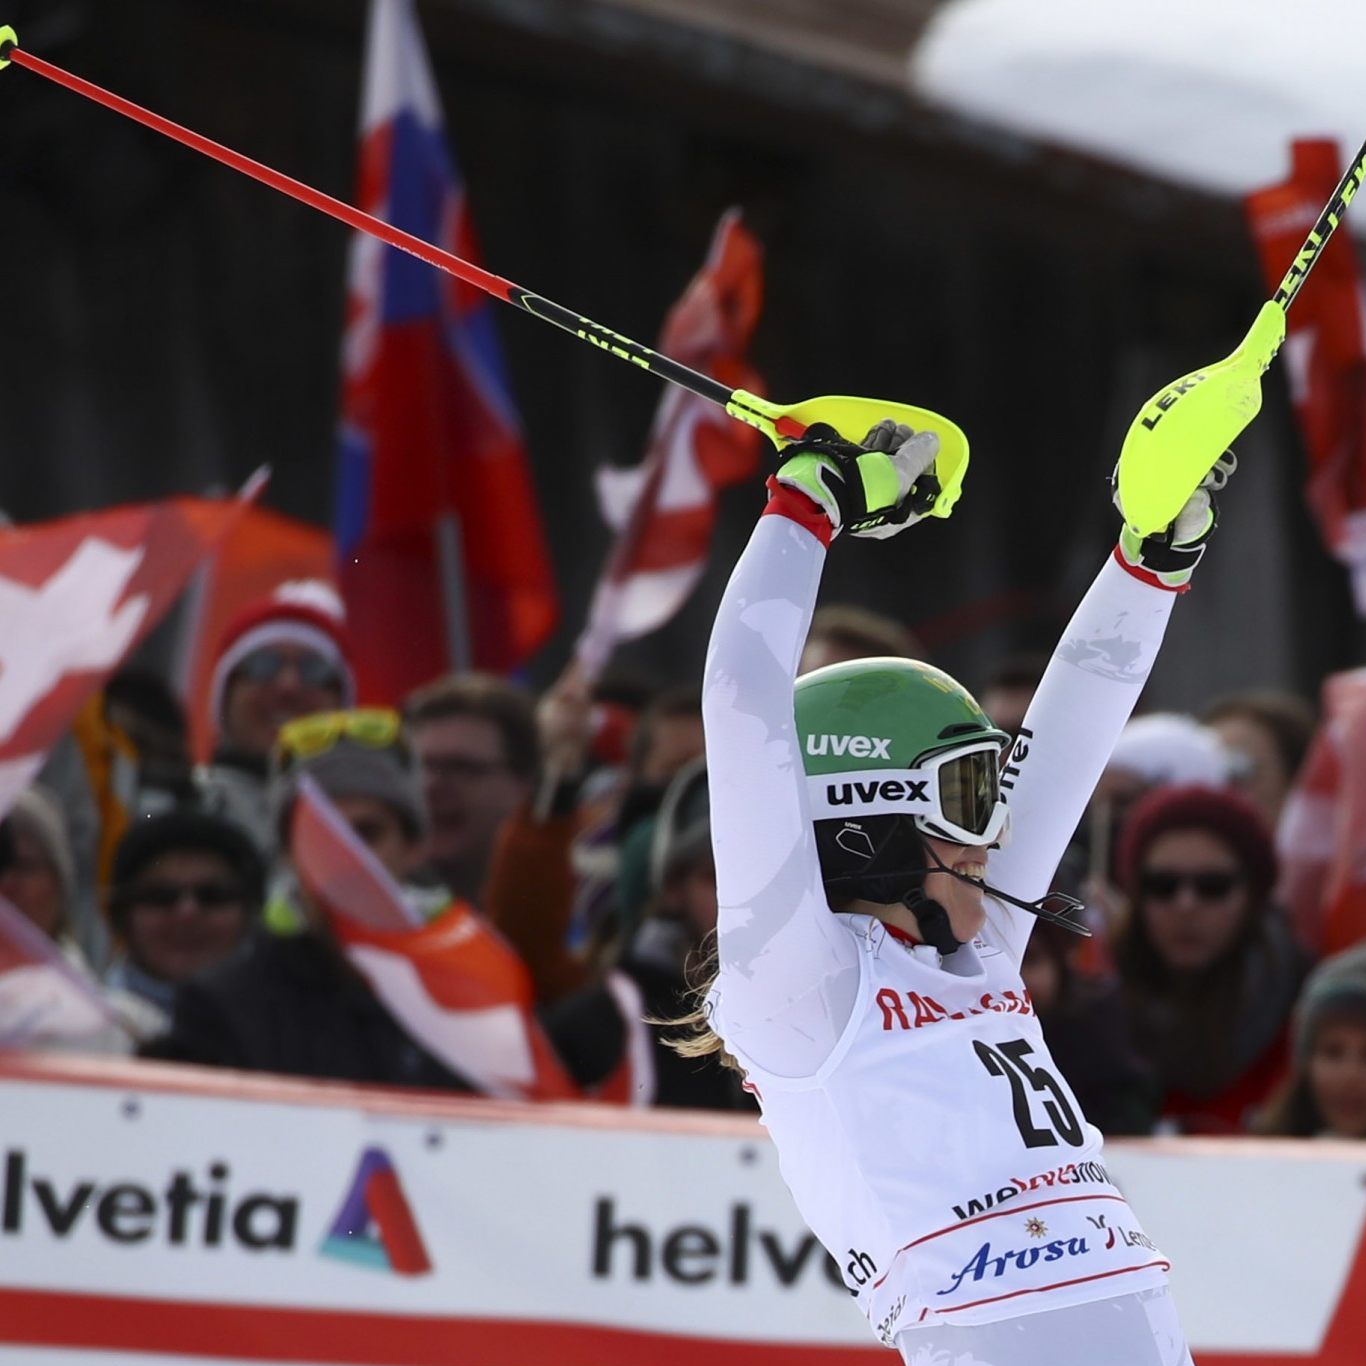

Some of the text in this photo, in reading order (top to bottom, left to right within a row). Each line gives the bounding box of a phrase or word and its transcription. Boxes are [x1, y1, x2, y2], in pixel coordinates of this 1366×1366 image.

[1141, 374, 1206, 431] LEKI
[806, 734, 892, 760] uvex
[827, 780, 932, 806] uvex
[972, 1038, 1085, 1149] 25
[936, 1238, 1091, 1296] Arosa
